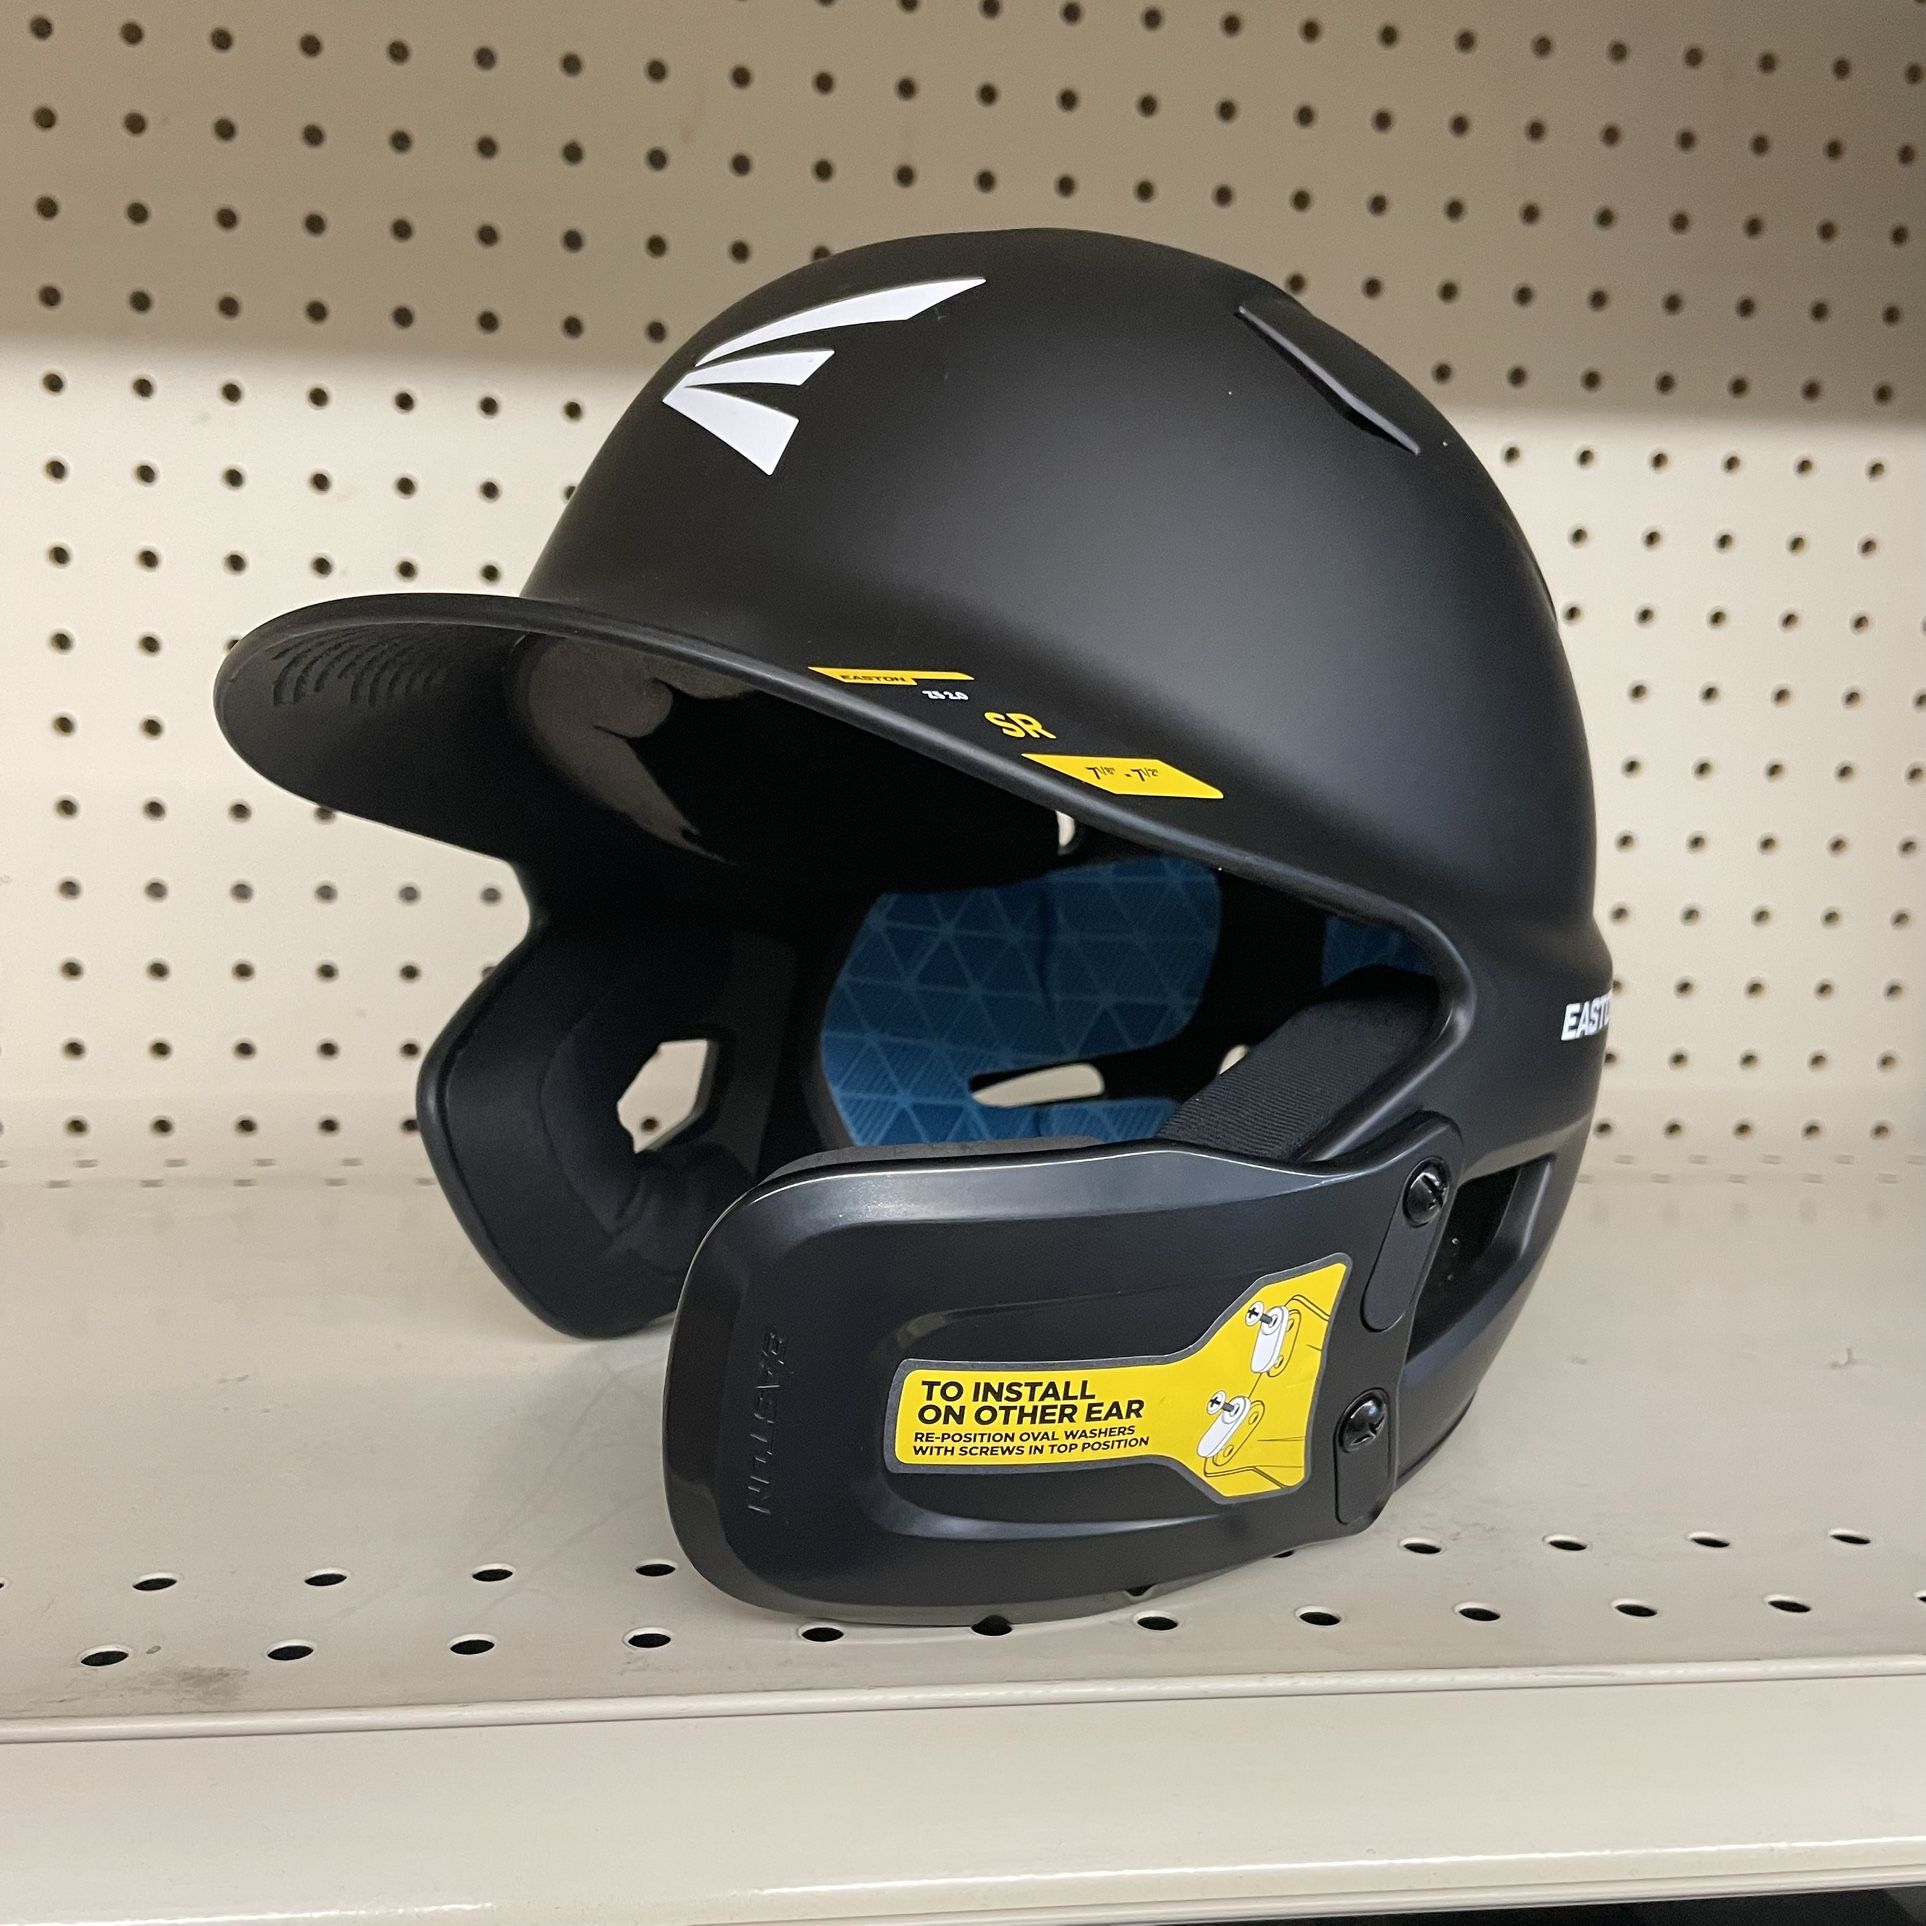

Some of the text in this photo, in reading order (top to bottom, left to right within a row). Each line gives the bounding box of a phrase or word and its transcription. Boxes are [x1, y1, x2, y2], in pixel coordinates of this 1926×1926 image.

[840, 674, 908, 683] EASTON
[984, 712, 1056, 739] SR
[921, 1380, 1096, 1402] TO INSTALL
[917, 1399, 1145, 1426] ON OTHER EAR
[913, 1425, 1136, 1443] RE-POSITION OVAL WASHERS
[913, 1434, 1150, 1456] WITH SCREWS IN TOP POSITION
